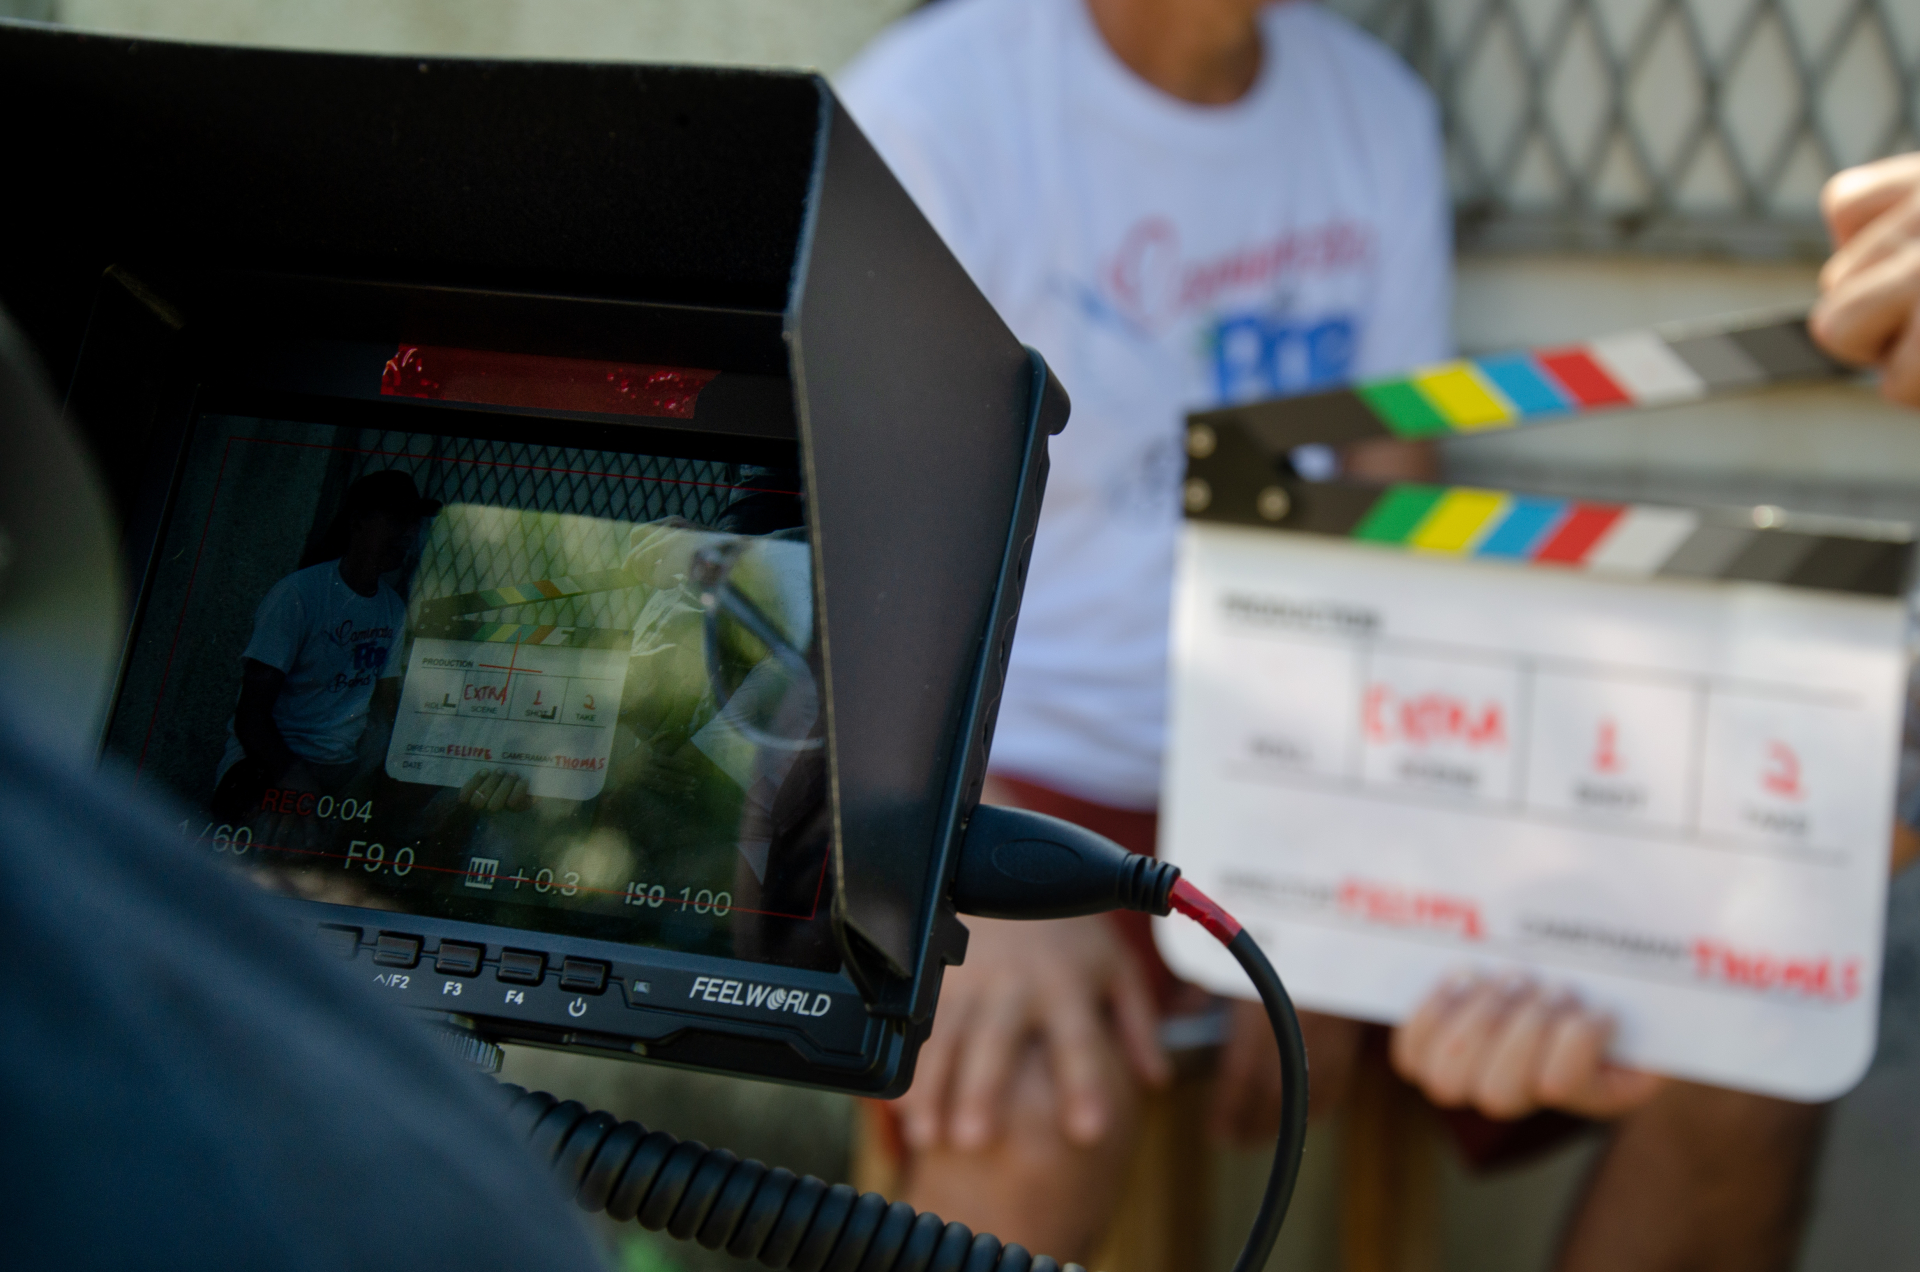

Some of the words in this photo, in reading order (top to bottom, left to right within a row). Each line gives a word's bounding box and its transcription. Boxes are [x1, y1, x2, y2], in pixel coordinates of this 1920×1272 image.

[422, 657, 474, 668] PRODUCTION
[471, 705, 498, 715] SCENE
[575, 713, 597, 722] TAKE
[403, 760, 423, 769] DATE
[406, 743, 446, 754] DIRECTOR
[502, 751, 554, 764] CAMERAMAN
[555, 755, 606, 770] THOMAS
[261, 788, 315, 816] REC
[317, 795, 373, 823] 0:04
[344, 840, 415, 877] F9.0
[508, 868, 580, 897] +0.3
[625, 881, 666, 909] ISO
[678, 887, 733, 918] 100
[442, 981, 463, 998] F3
[504, 989, 525, 1006] F4
[689, 976, 832, 1018] FEELWORLD
